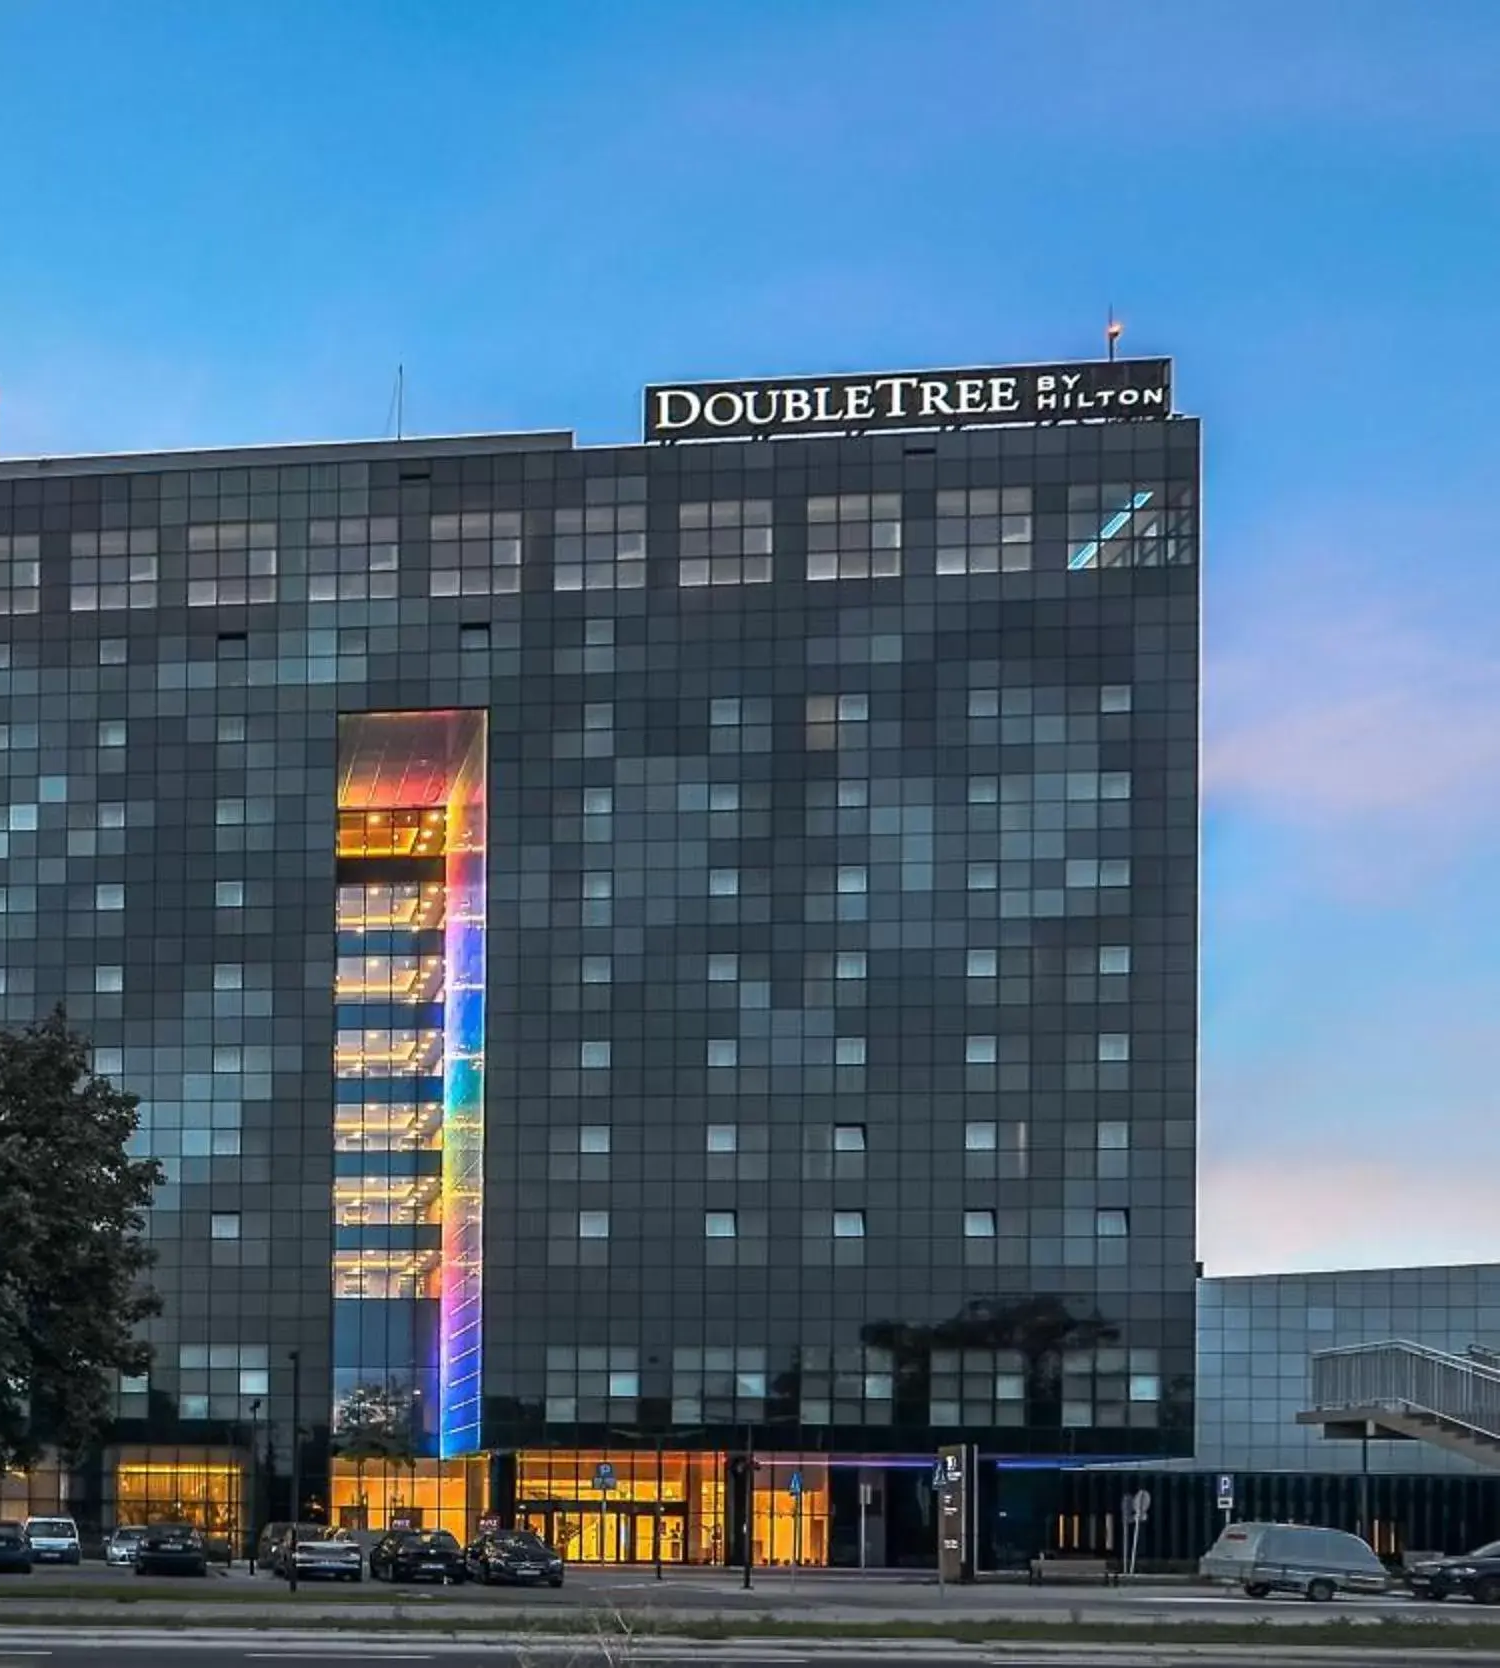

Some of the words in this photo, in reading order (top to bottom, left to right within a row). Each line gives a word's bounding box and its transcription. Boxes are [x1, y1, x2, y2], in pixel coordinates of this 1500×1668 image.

[1037, 373, 1081, 392] BY
[1037, 387, 1164, 410] HILTON
[1221, 1475, 1231, 1495] P
